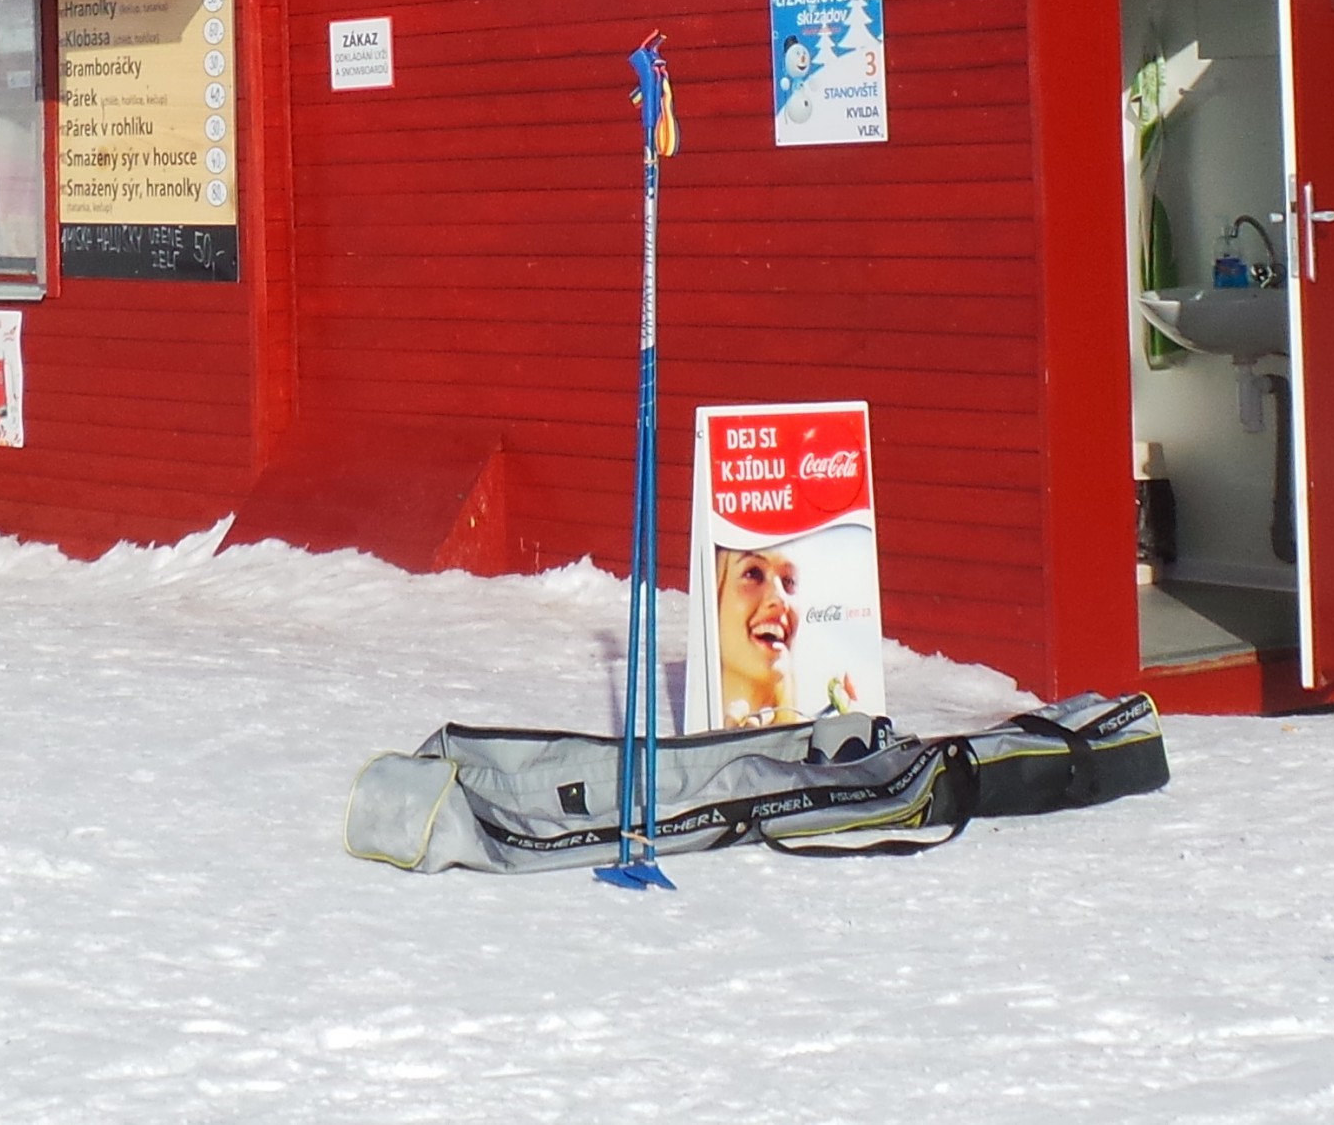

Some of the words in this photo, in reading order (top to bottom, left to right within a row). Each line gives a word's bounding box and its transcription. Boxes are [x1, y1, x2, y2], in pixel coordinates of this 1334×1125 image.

[65, 27, 110, 47] Klobása
[343, 30, 379, 48] ZÁKAZ
[66, 55, 142, 80] Bramboráčky
[865, 51, 877, 76] 3
[66, 88, 97, 107] Párek
[824, 82, 878, 99] STANOVIŠTĚ
[846, 106, 879, 119] KVILDA
[67, 117, 97, 137] Párek
[101, 123, 108, 136] v
[858, 125, 880, 137] VLEK
[67, 148, 117, 171] Smažený
[122, 147, 139, 171] sýr
[143, 152, 150, 165] v
[153, 146, 197, 166] housce
[67, 178, 118, 201] Smažený
[122, 177, 143, 201] sýr,
[146, 177, 202, 202] hranolky
[727, 428, 755, 449] DEJ
[759, 427, 777, 448] SI
[721, 461, 734, 482] K
[736, 455, 785, 481] JÍDLU
[716, 492, 737, 514] TO
[741, 484, 793, 512] PRAVÉ
[1098, 700, 1152, 735] FISCHER
[887, 752, 928, 795] FISCHER
[751, 797, 802, 819] FISCHER
[506, 834, 582, 851] FISCHER
